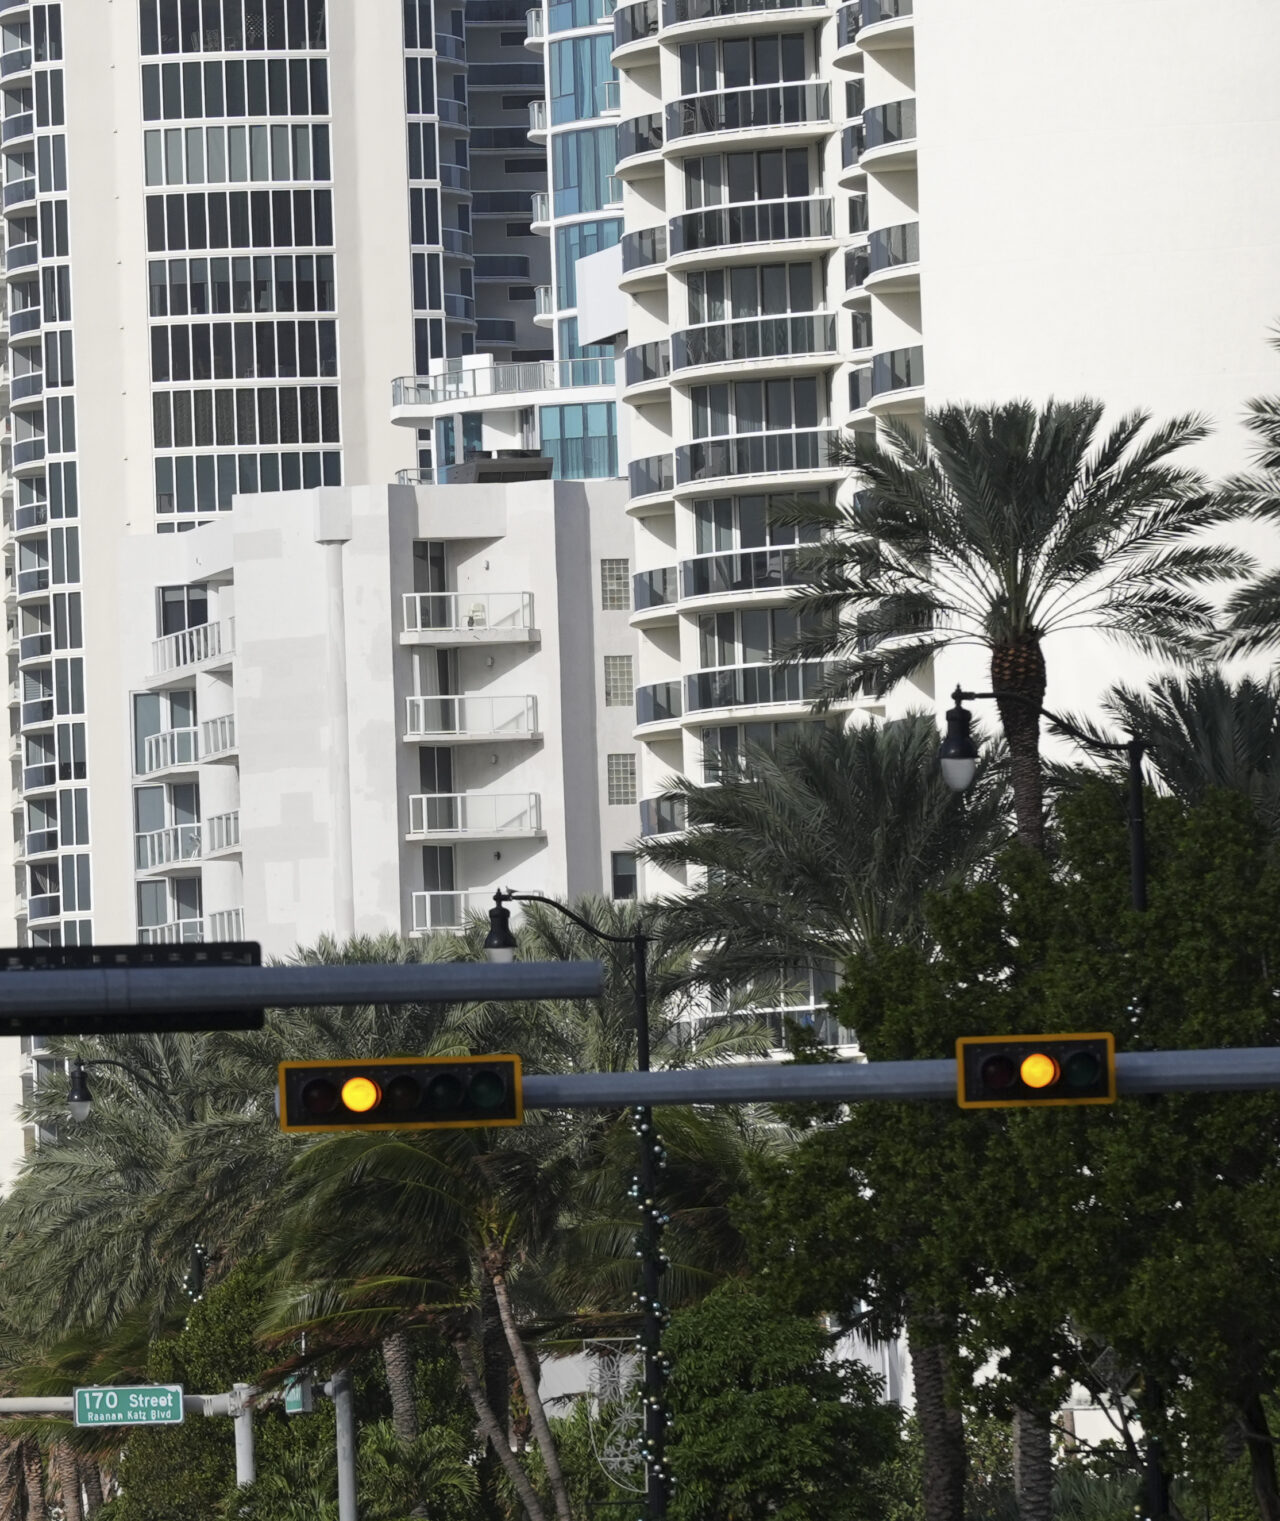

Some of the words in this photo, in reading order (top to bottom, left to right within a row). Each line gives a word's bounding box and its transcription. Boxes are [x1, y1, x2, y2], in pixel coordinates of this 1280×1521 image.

[84, 1391, 118, 1409] 170
[129, 1393, 173, 1408] Street
[128, 1410, 147, 1420] Katz
[151, 1409, 171, 1420] Blvd
